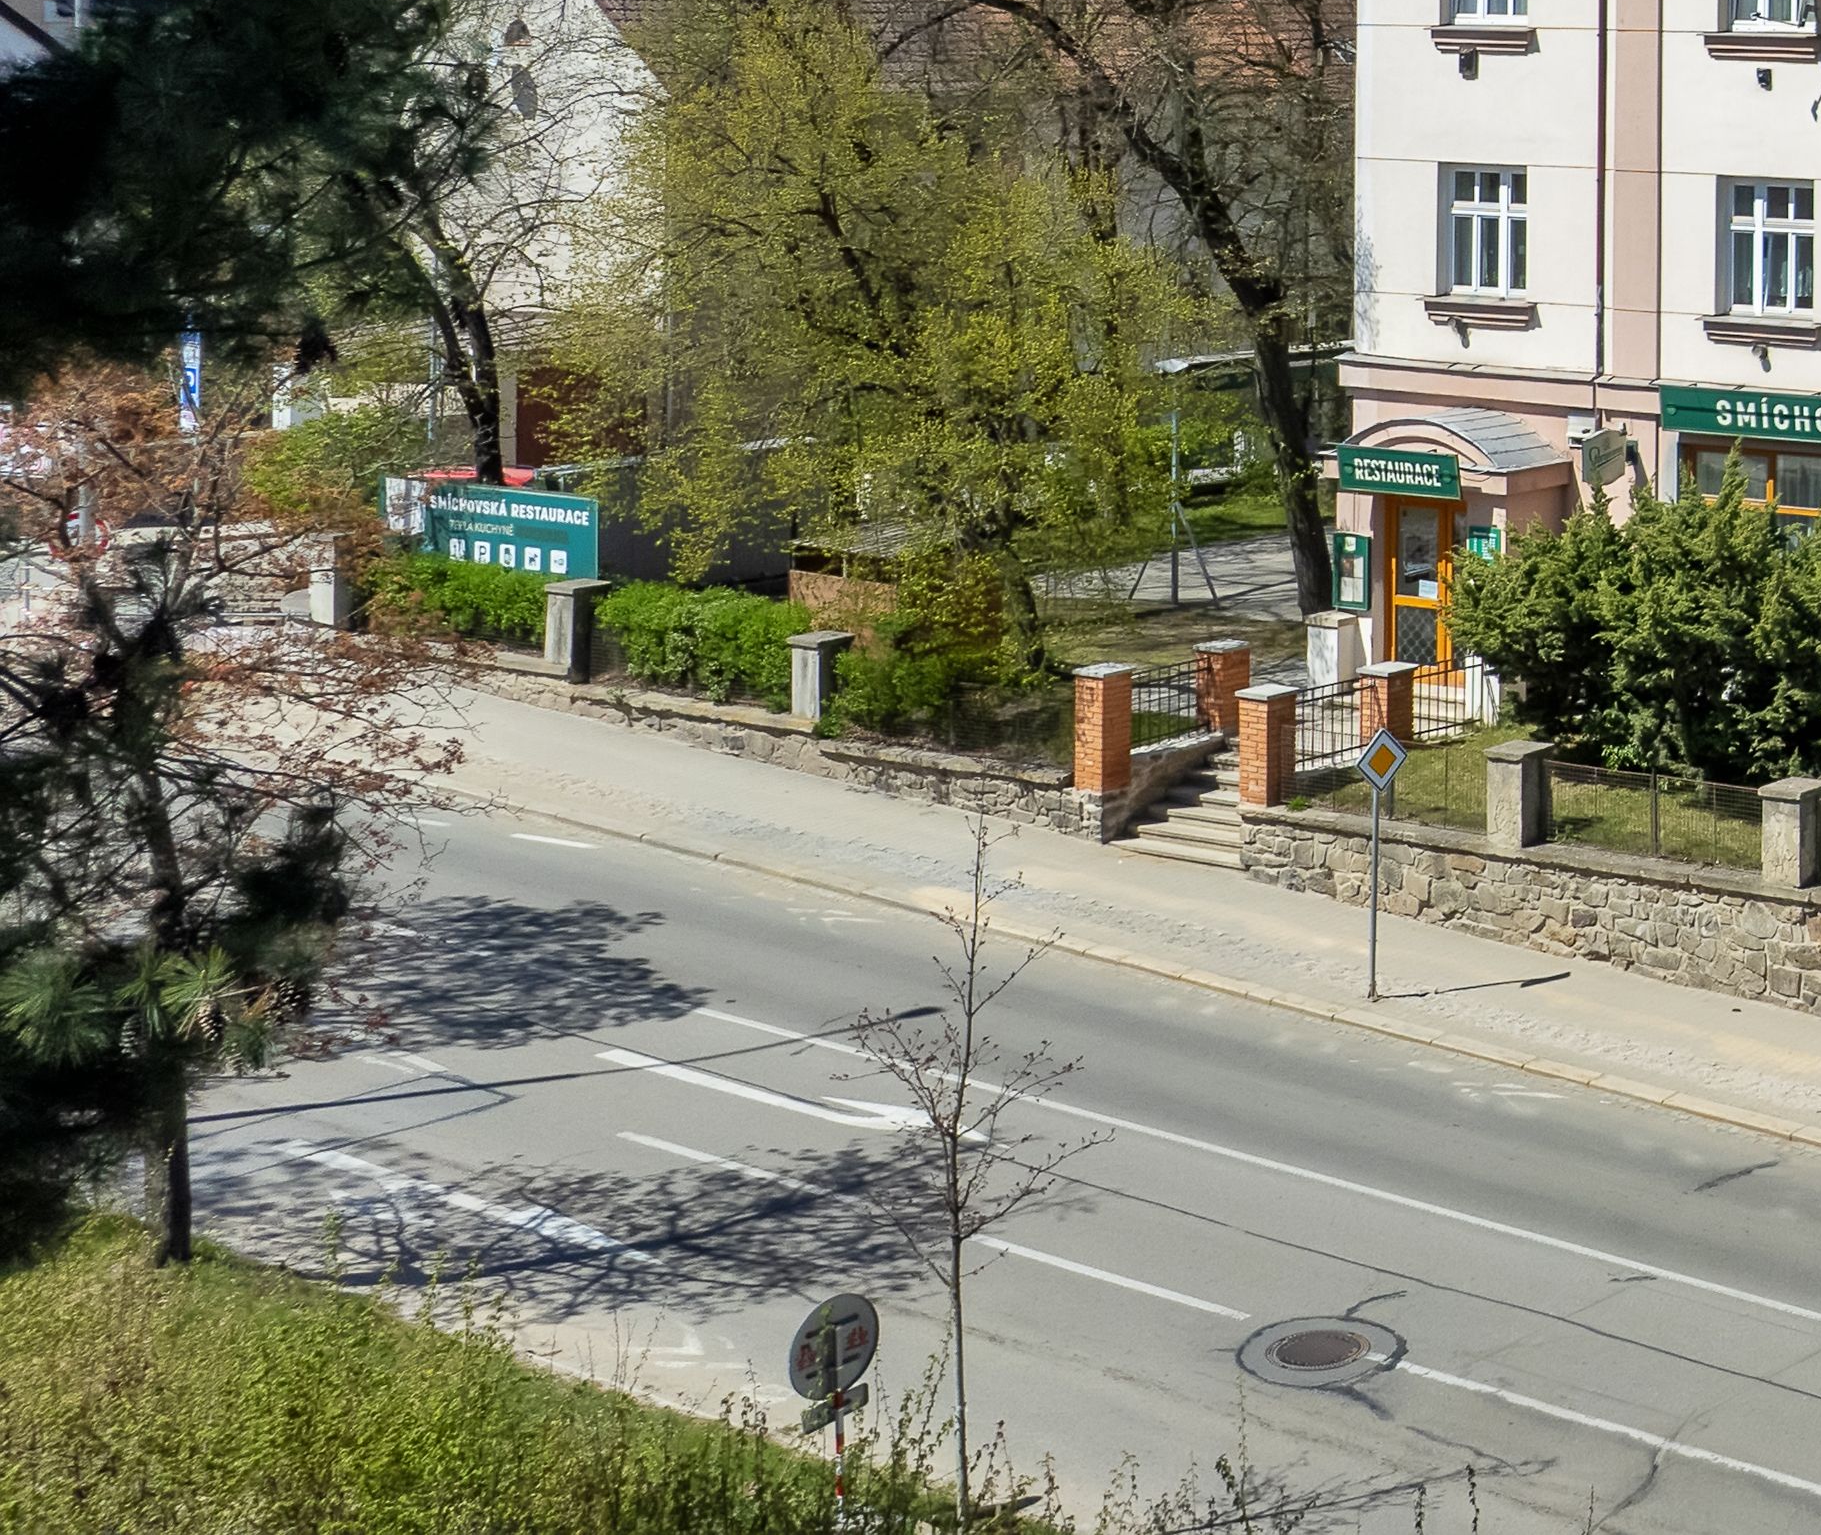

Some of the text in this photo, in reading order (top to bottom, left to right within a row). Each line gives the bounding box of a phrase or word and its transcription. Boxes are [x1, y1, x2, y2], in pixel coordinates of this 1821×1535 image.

[1353, 457, 1442, 487] RESTAURACE
[429, 493, 507, 517] SMÍCHOVSKÁ
[510, 503, 590, 526] RESTAURACE
